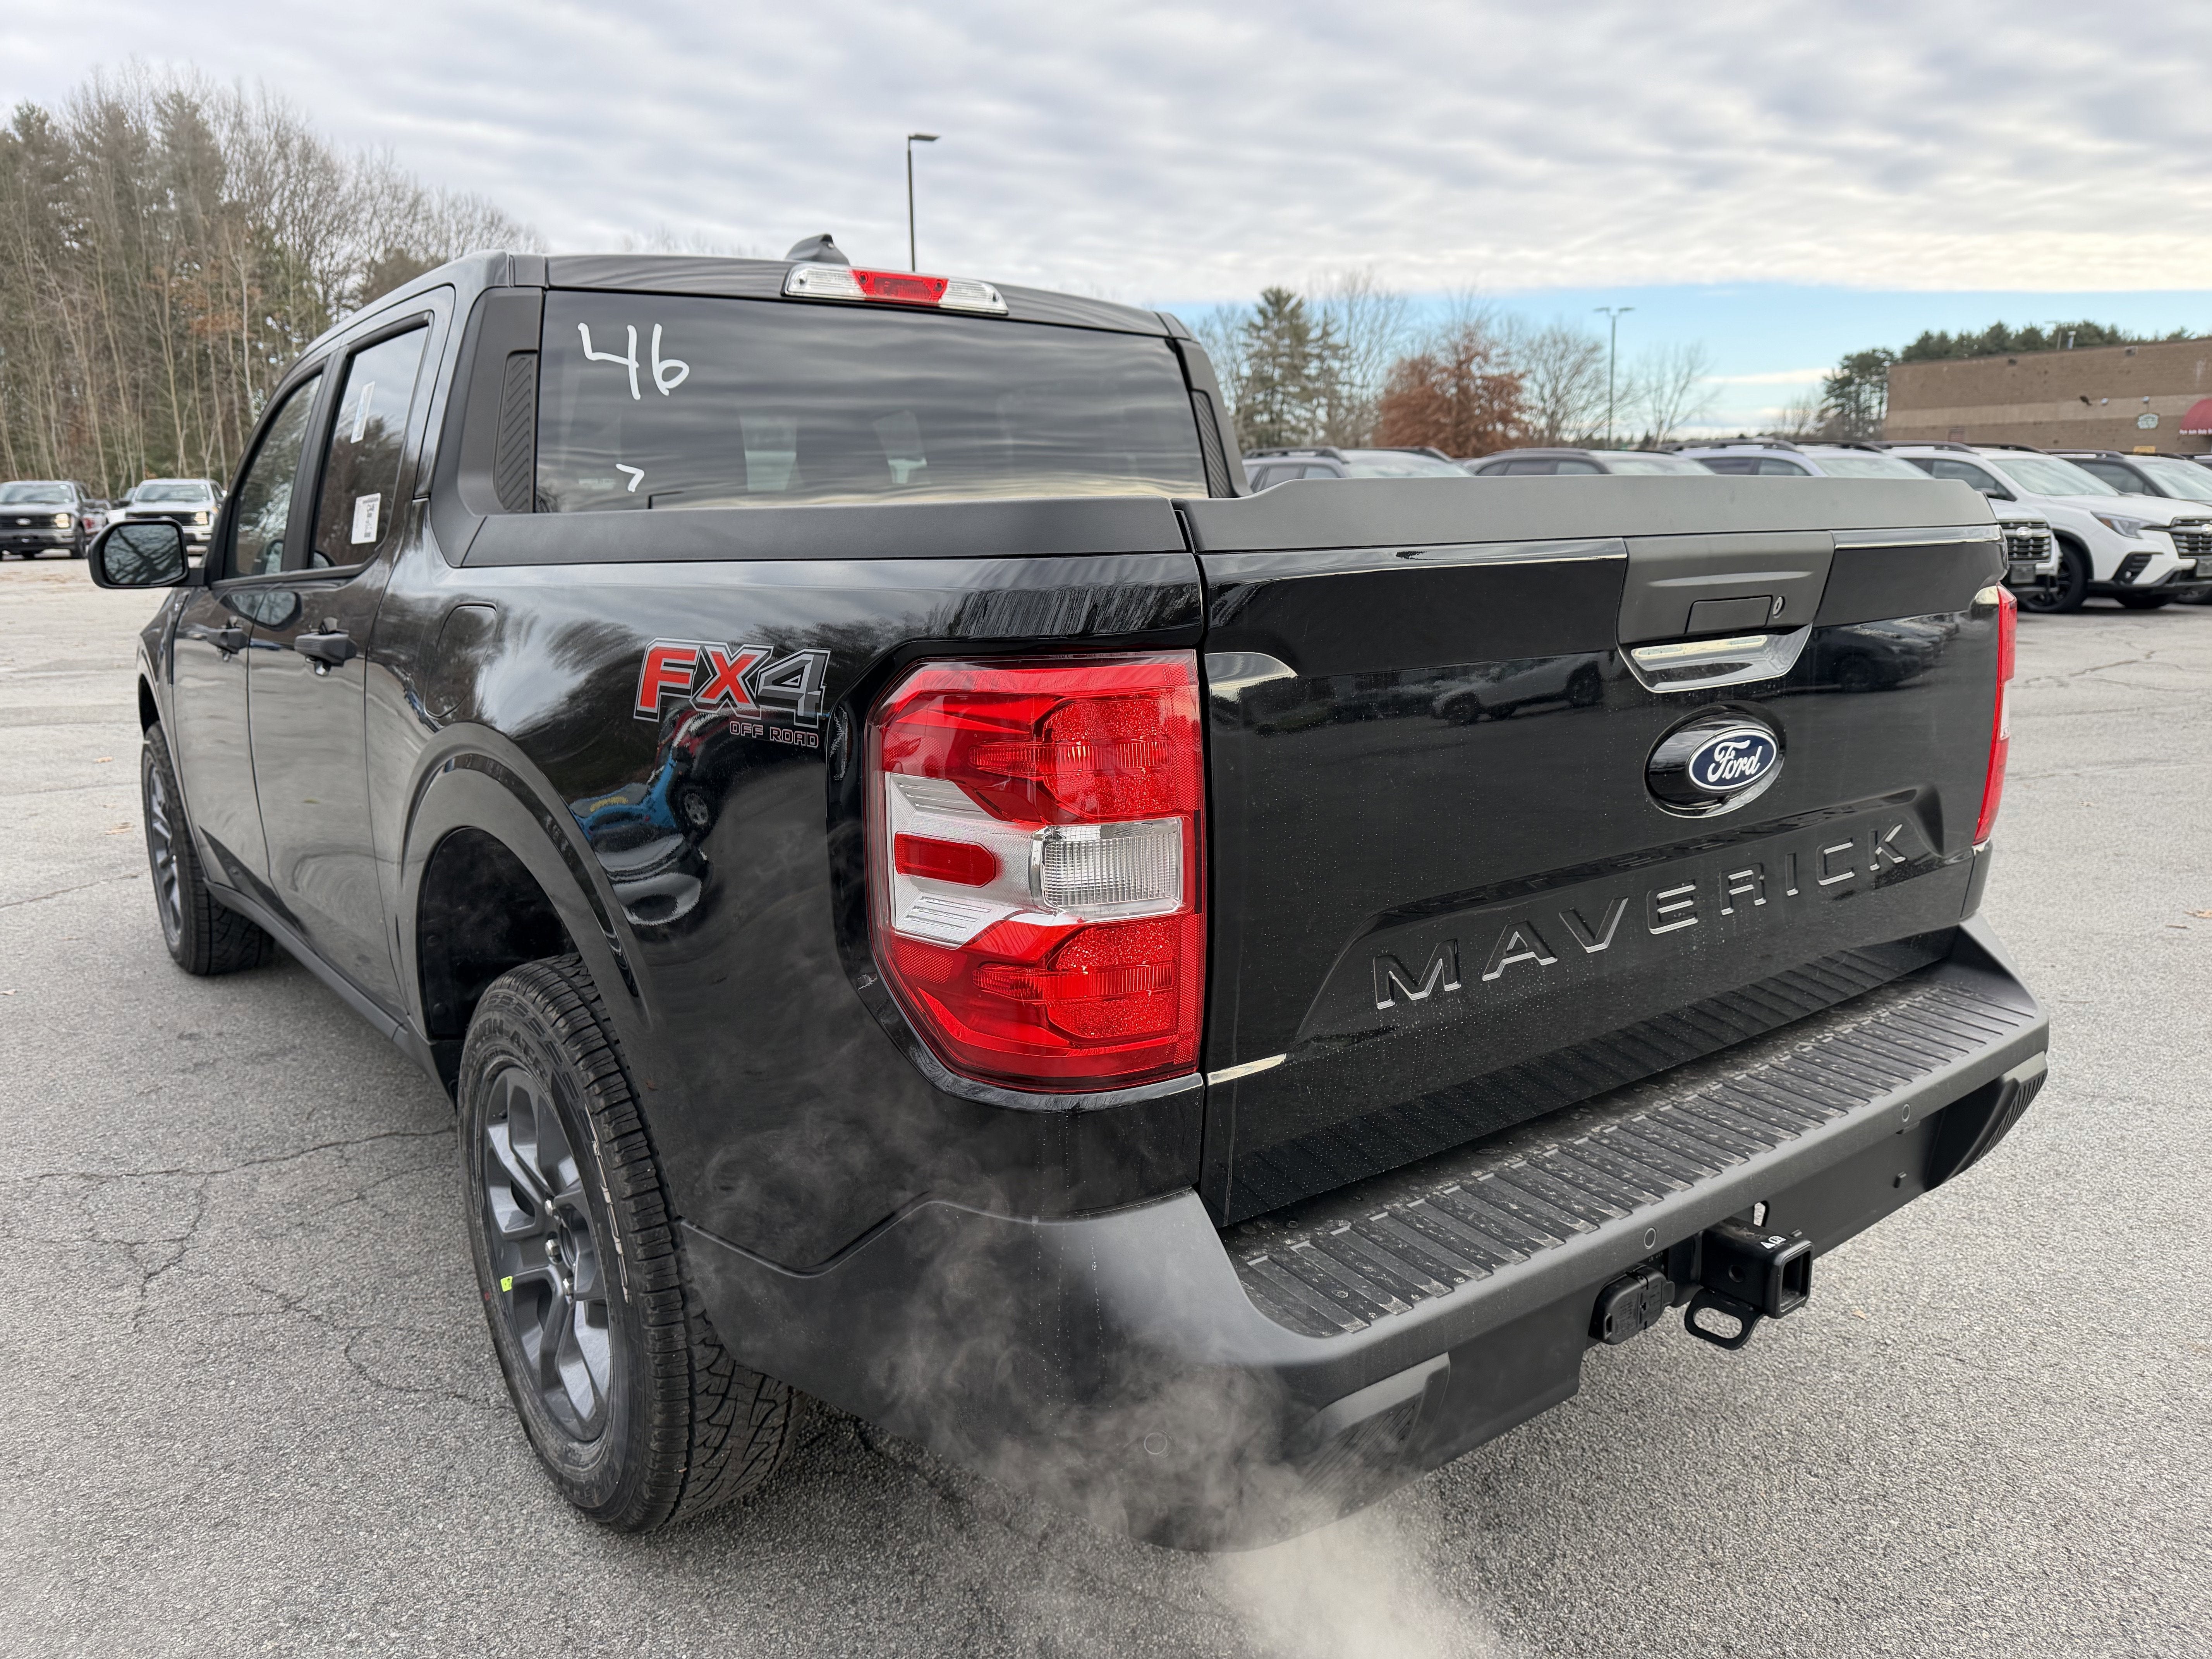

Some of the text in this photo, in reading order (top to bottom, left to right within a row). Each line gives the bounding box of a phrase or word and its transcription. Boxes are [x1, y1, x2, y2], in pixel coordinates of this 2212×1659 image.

[578, 323, 689, 400] 46
[634, 637, 831, 728] FX4
[730, 721, 819, 748] OFF ROAD
[1707, 739, 1762, 782] Ford
[1373, 823, 1905, 1009] MAVERICK
